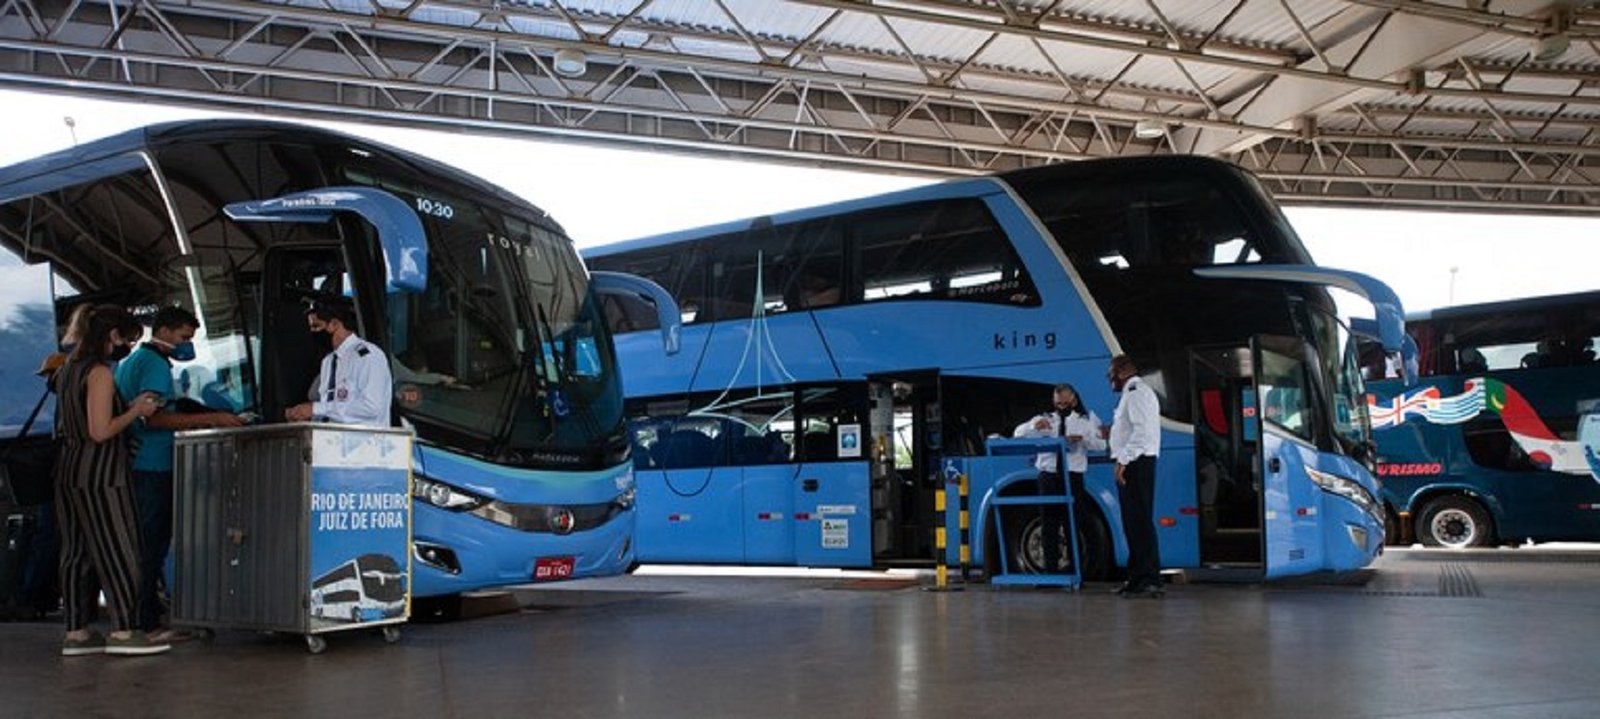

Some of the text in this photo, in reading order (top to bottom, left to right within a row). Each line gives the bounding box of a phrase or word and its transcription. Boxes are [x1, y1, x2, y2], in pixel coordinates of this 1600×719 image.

[994, 331, 1056, 349] king
[1377, 463, 1441, 475] URISMO
[311, 493, 409, 511] RIO DE JANEIRO
[319, 512, 404, 531] JUIZ DE FORA
